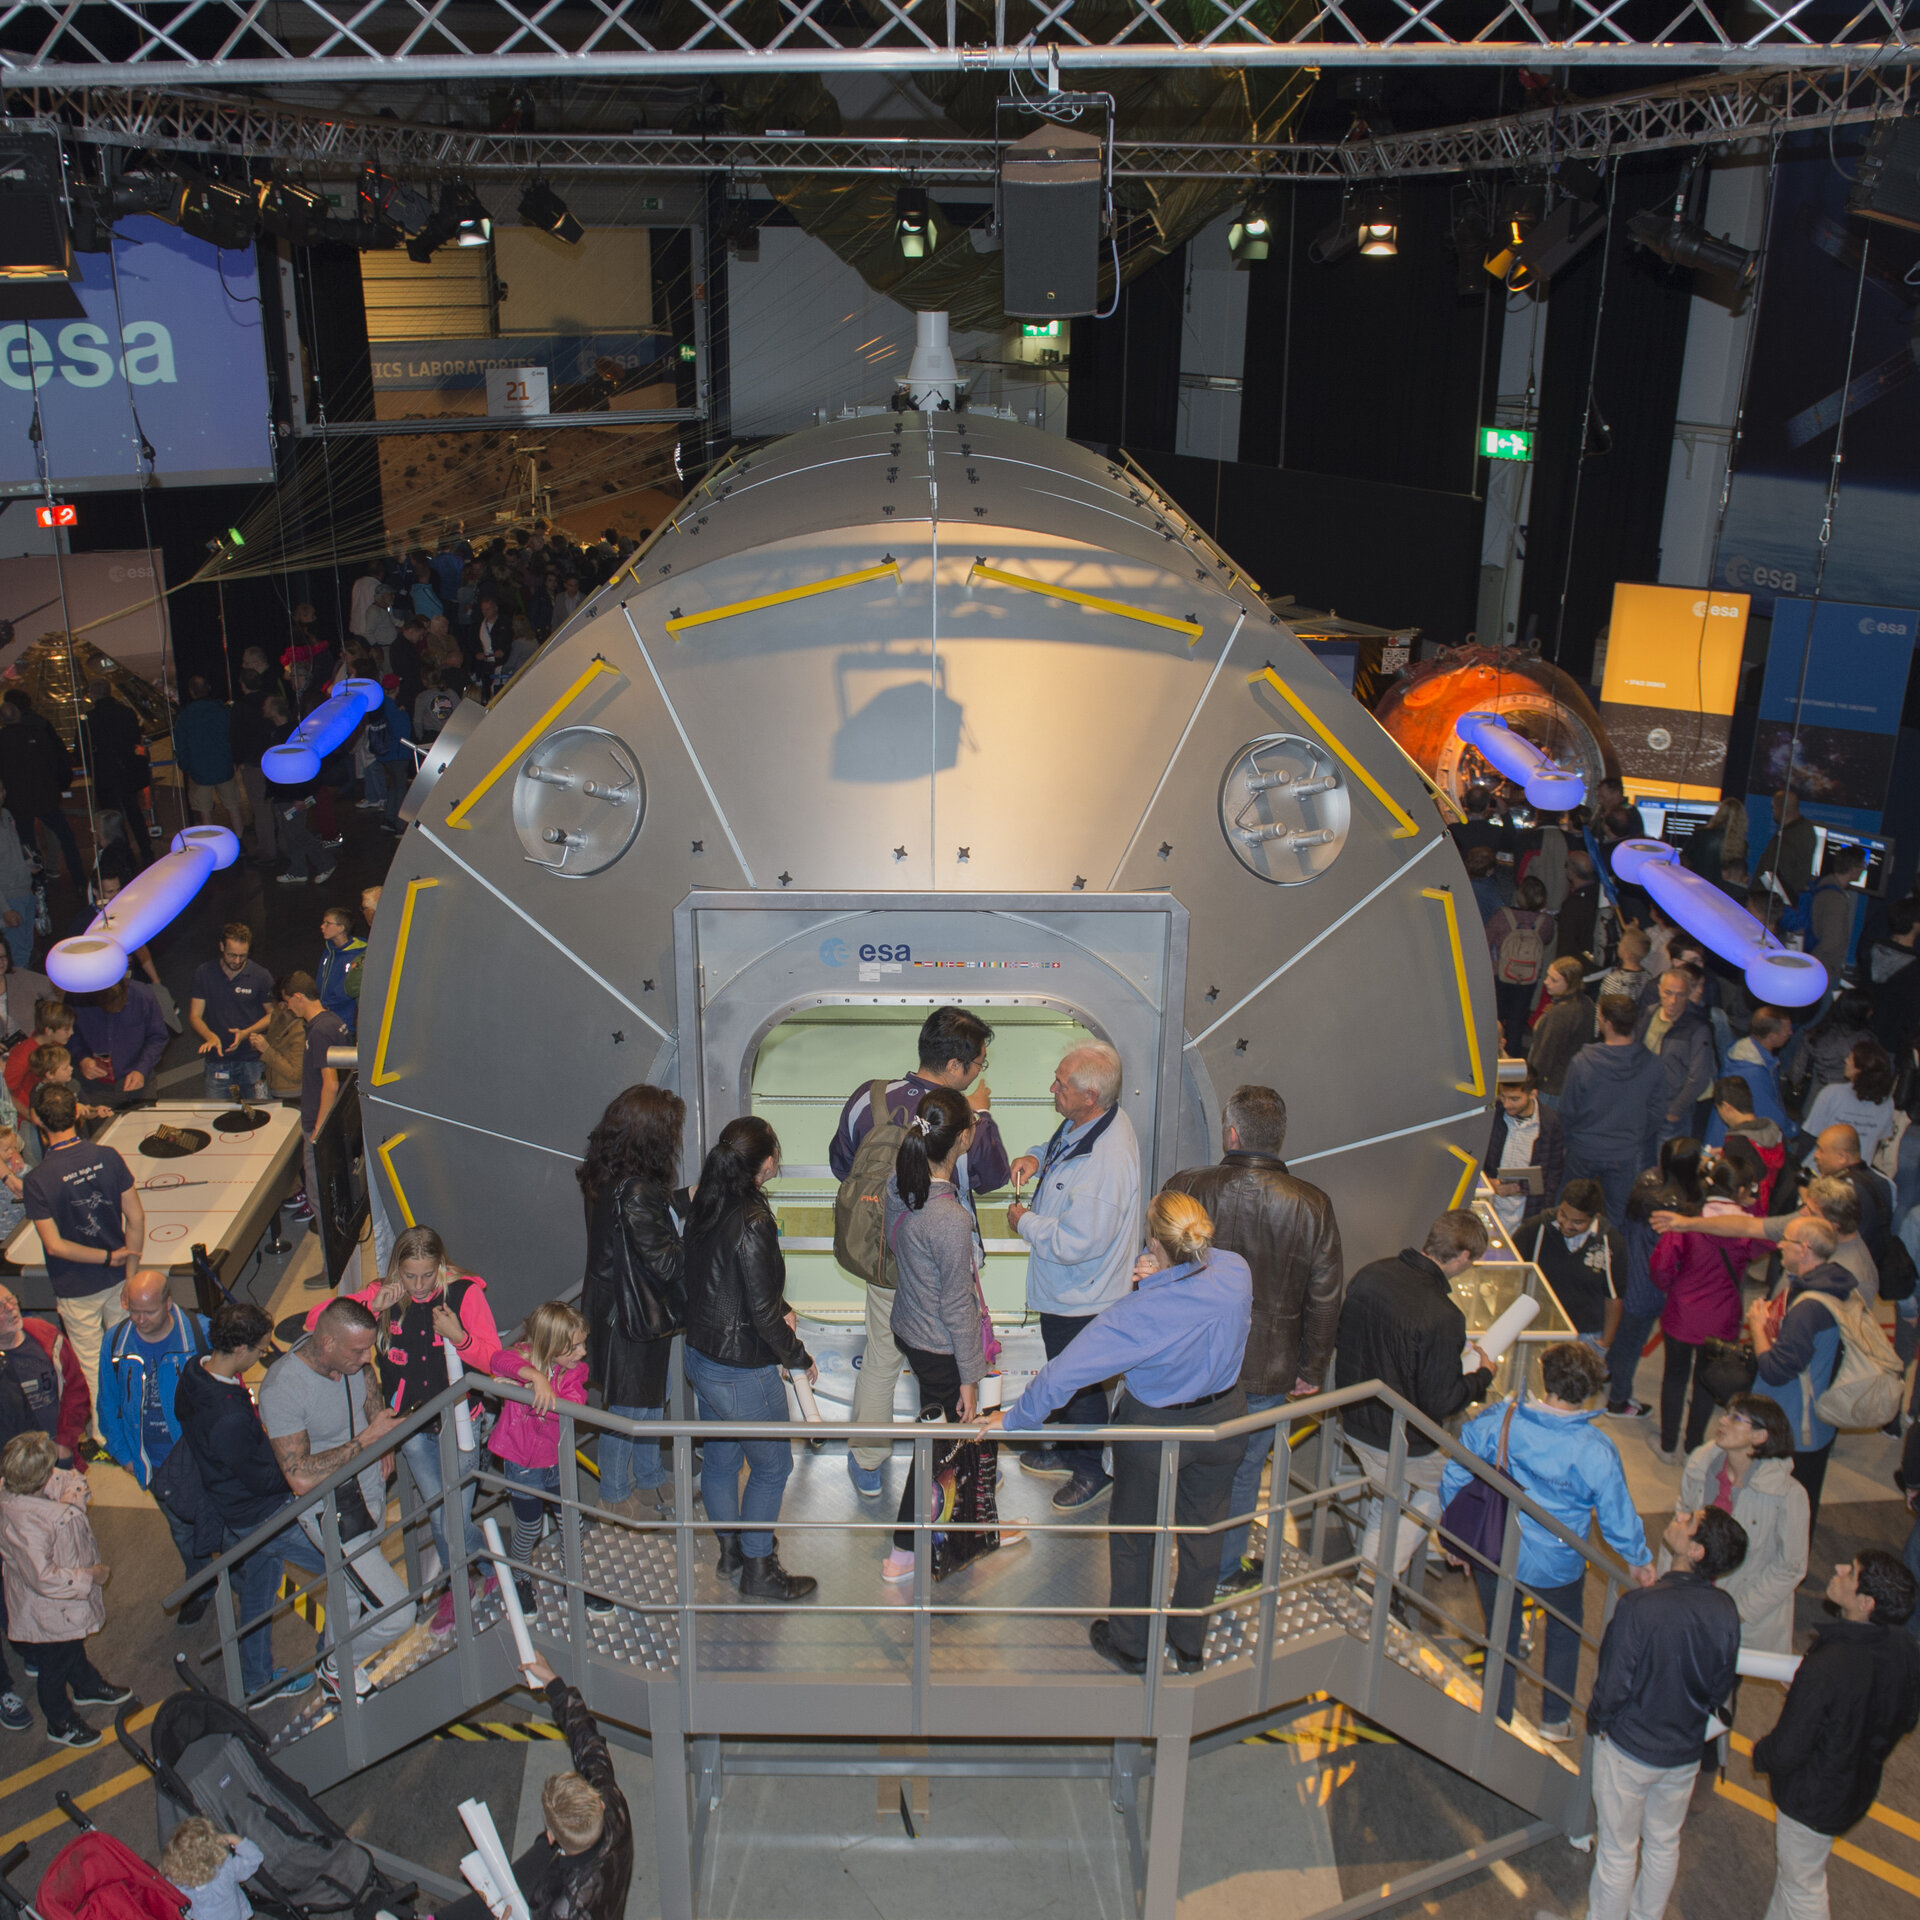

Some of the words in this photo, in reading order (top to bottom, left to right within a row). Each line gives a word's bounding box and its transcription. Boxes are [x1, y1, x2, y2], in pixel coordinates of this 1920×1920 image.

[0, 321, 178, 391] esa
[506, 381, 529, 401] 21
[127, 567, 155, 578] esa
[1753, 566, 1798, 592] esa
[1710, 605, 1739, 618] esa
[1877, 621, 1907, 635] esa
[859, 944, 911, 961] esa
